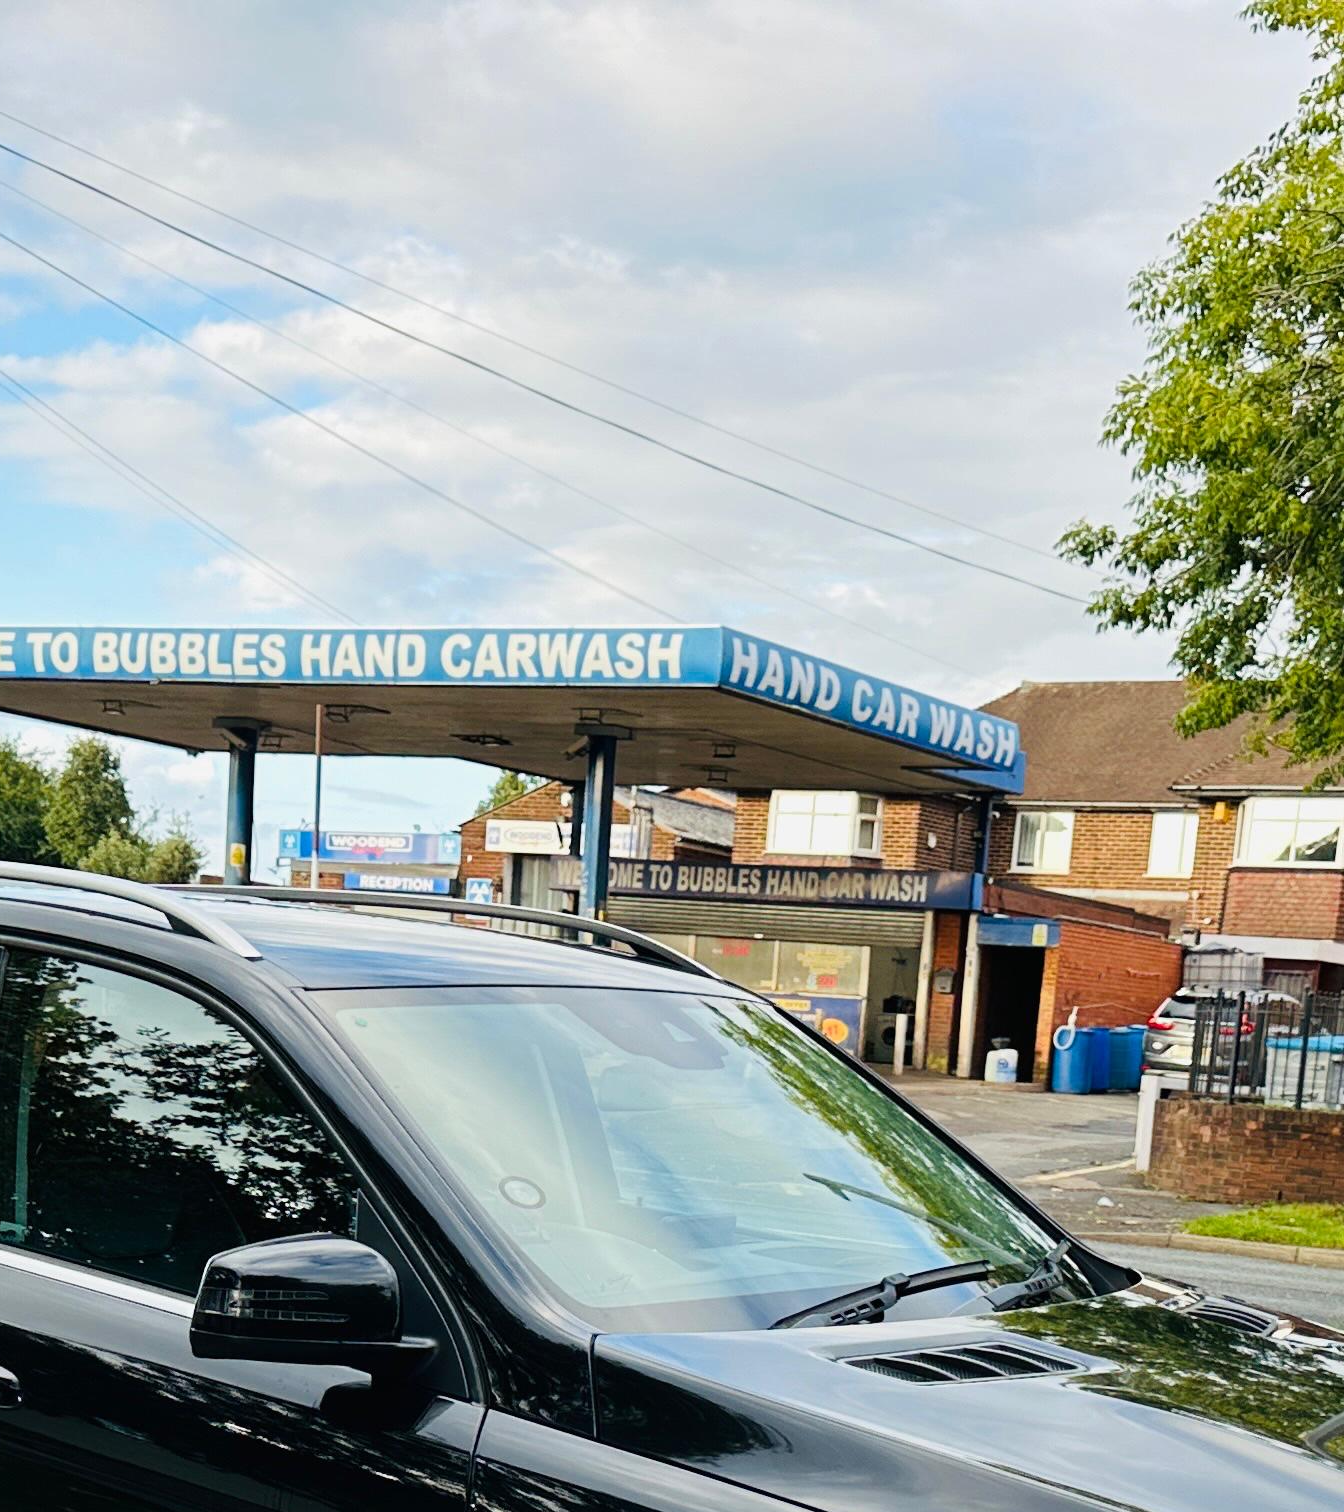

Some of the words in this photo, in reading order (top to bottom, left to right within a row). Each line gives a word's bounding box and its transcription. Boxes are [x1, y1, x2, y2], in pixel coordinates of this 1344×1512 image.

[26, 631, 79, 674] TO
[93, 632, 287, 677] BUBBLES
[300, 633, 427, 678] HAND
[440, 633, 685, 679] CARWASH
[728, 636, 842, 712] HAND
[851, 679, 921, 739] CAR
[929, 702, 1017, 767] WASH
[332, 835, 407, 848] WOODEND
[359, 874, 434, 892] RECEPTION
[649, 864, 672, 891] TO
[676, 865, 761, 895] BUBBLES
[765, 869, 819, 897] HAND
[825, 871, 865, 899] CAR
[870, 873, 928, 903] WASH
